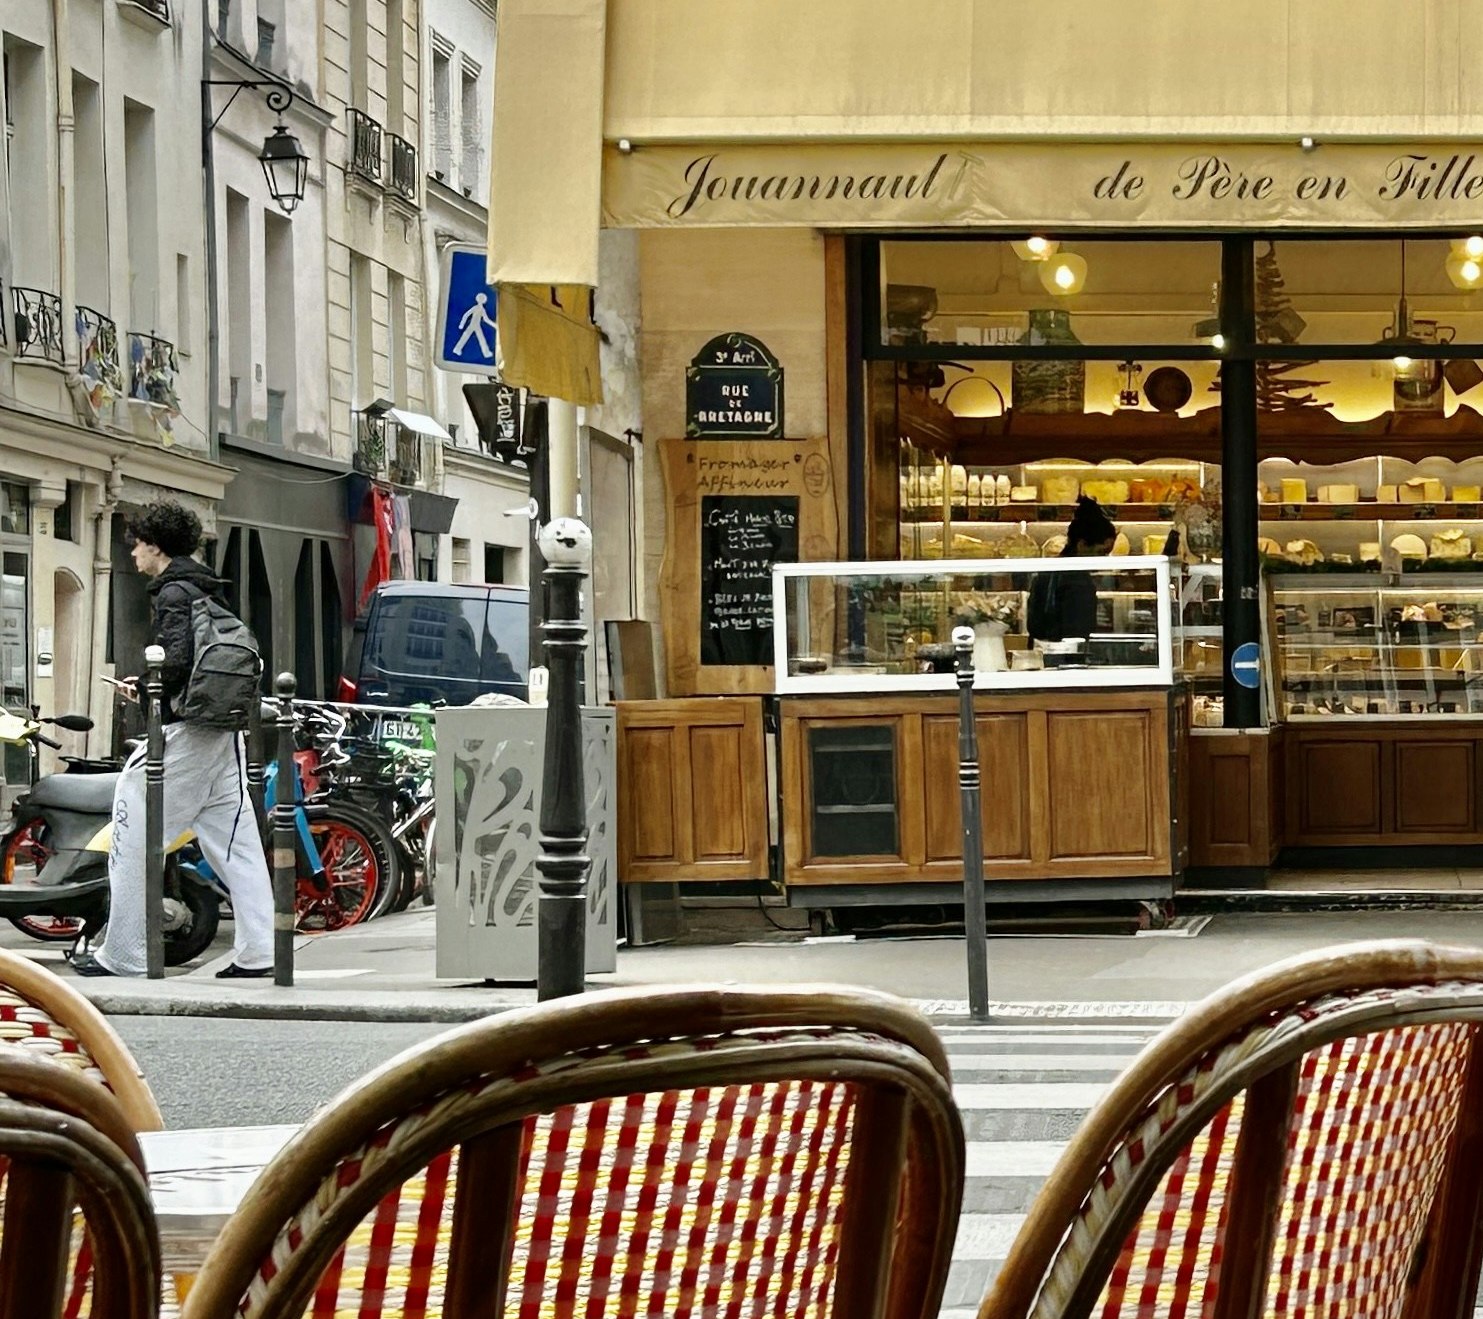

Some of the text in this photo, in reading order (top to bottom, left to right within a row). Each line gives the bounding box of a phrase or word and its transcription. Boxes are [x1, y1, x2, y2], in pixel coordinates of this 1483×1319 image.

[1093, 160, 1146, 201] de
[1171, 154, 1275, 201] Père
[1296, 171, 1351, 201] en
[721, 384, 750, 397] RUE
